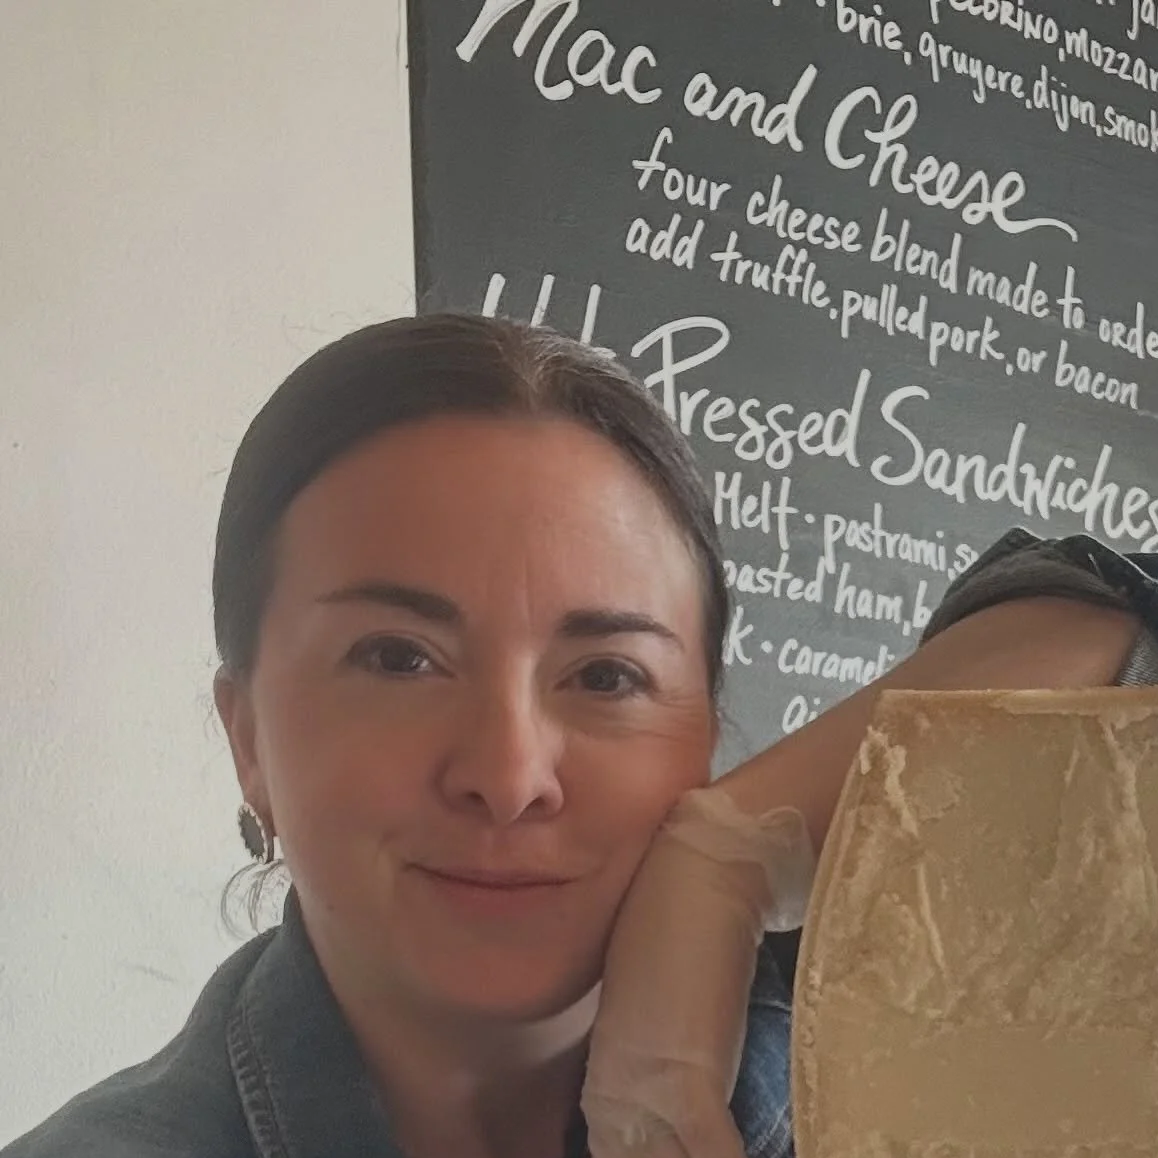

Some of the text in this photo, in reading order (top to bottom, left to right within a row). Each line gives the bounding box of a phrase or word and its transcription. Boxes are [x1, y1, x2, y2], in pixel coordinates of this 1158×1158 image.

[455, 0, 1079, 243] Mac and Cheese
[625, 213, 706, 271] add
[841, 283, 928, 340] pulled
[1016, 347, 1048, 374] or
[1054, 340, 1139, 410] bacon
[632, 126, 733, 212] four
[746, 174, 864, 253] cheese
[869, 208, 963, 295] blend
[966, 261, 1051, 319] made
[1056, 265, 1086, 330] to
[630, 315, 873, 471] Pressed
[713, 471, 799, 552] Melt
[723, 552, 826, 603] oasted
